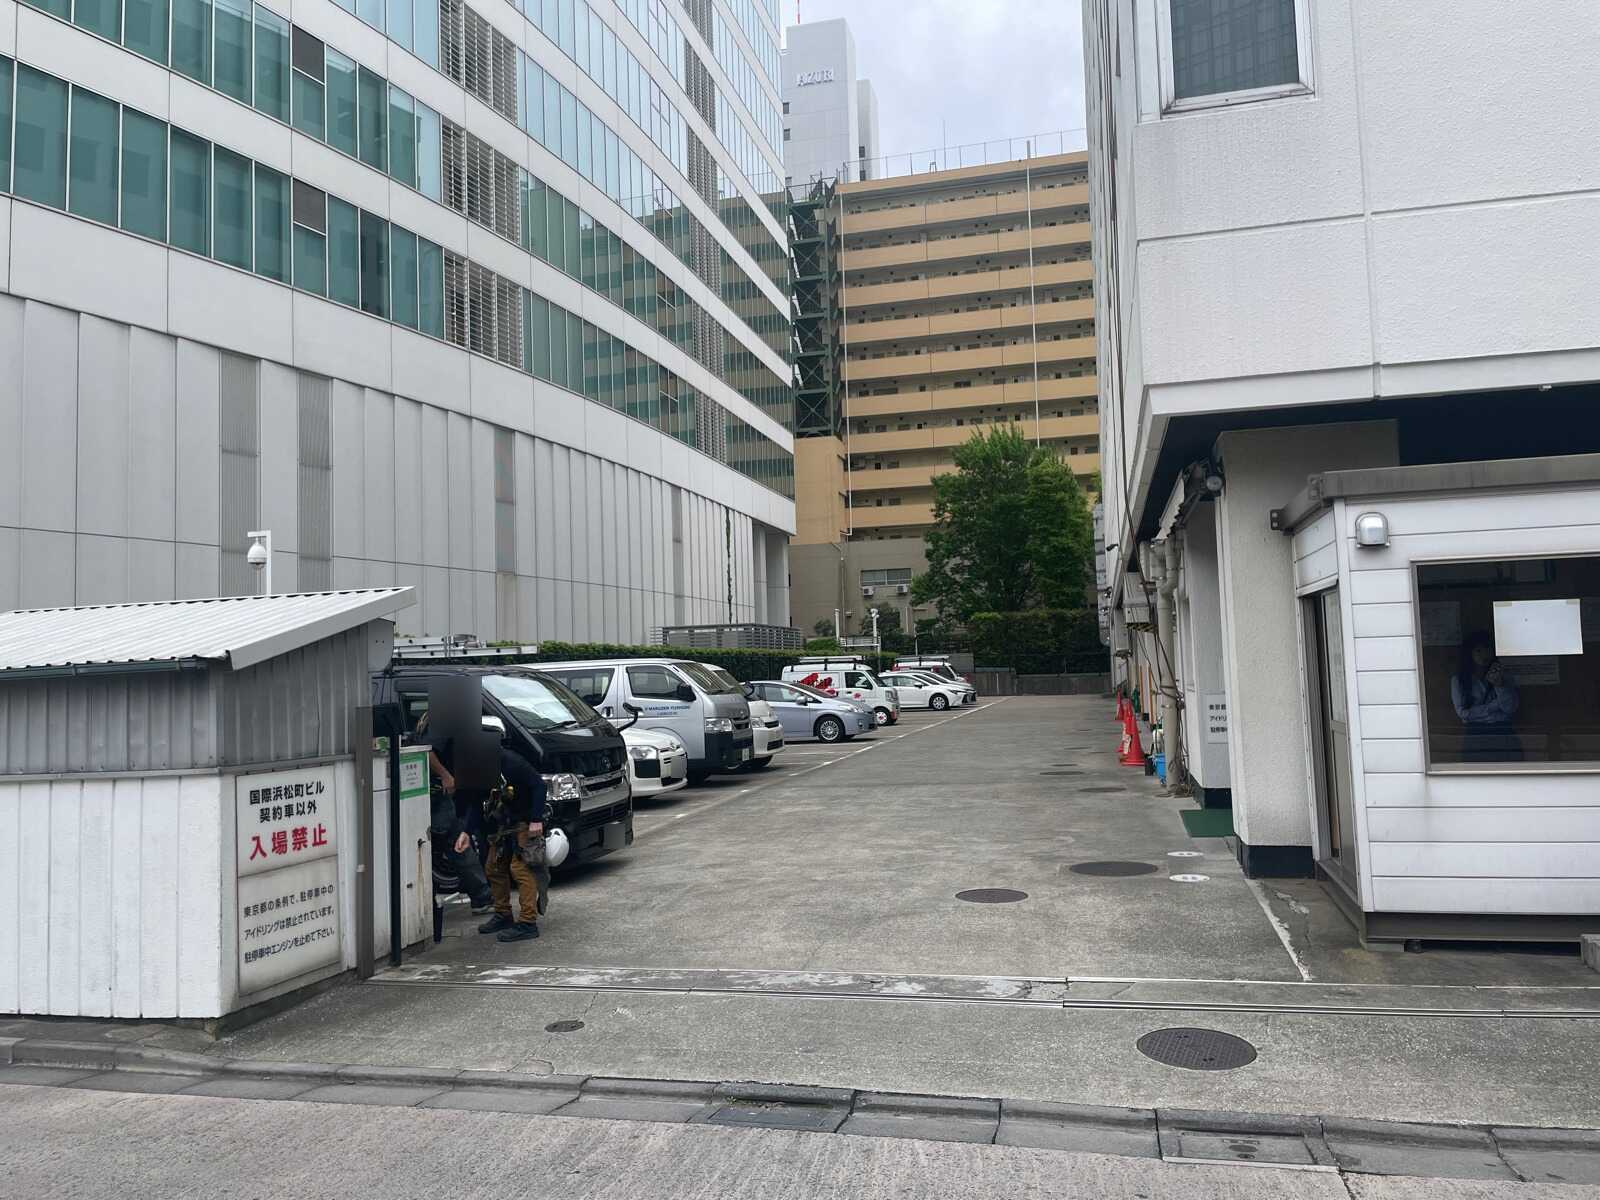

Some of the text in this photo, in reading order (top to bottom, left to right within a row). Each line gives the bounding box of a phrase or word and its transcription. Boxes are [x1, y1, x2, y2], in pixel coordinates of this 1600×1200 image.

[250, 781, 324, 805] 国際浜松町ビル
[260, 800, 317, 823] 契約車以外
[250, 824, 327, 860] 入場禁止
